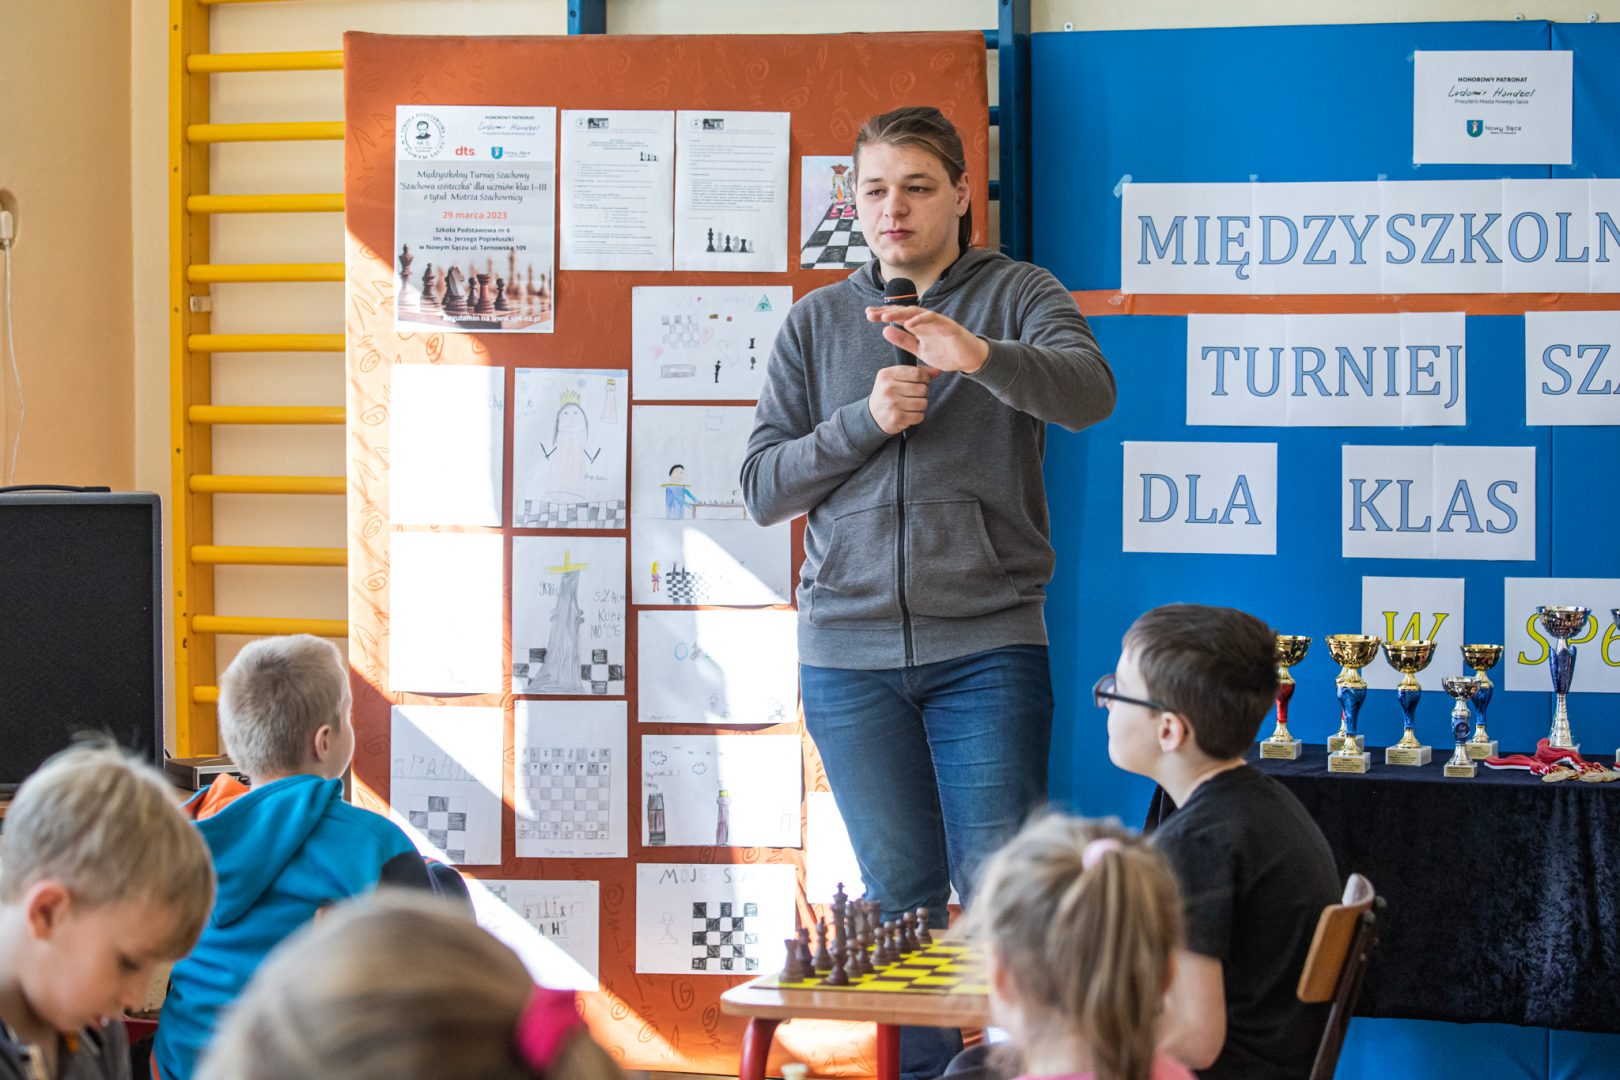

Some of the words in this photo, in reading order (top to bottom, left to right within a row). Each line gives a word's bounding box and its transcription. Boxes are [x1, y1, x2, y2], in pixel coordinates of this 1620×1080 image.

[1448, 85, 1487, 97] Ludomir
[1493, 87, 1536, 97] Handzel
[455, 146, 475, 156] dts
[417, 170, 468, 181] Międzyszkolny
[469, 171, 495, 180] Turniej
[496, 170, 530, 181] Szachowy
[474, 182, 485, 190] dla
[487, 182, 514, 191] uczniów
[515, 181, 530, 190] klas
[451, 192, 478, 200] Mistrza
[479, 192, 523, 204] Szachownicy
[442, 211, 453, 219] 29
[486, 211, 508, 219] 2023
[1201, 344, 1463, 408] TURNIEJ
[1542, 344, 1620, 395] SZ
[1139, 473, 1262, 525] DLA
[1349, 479, 1519, 533] KLAS
